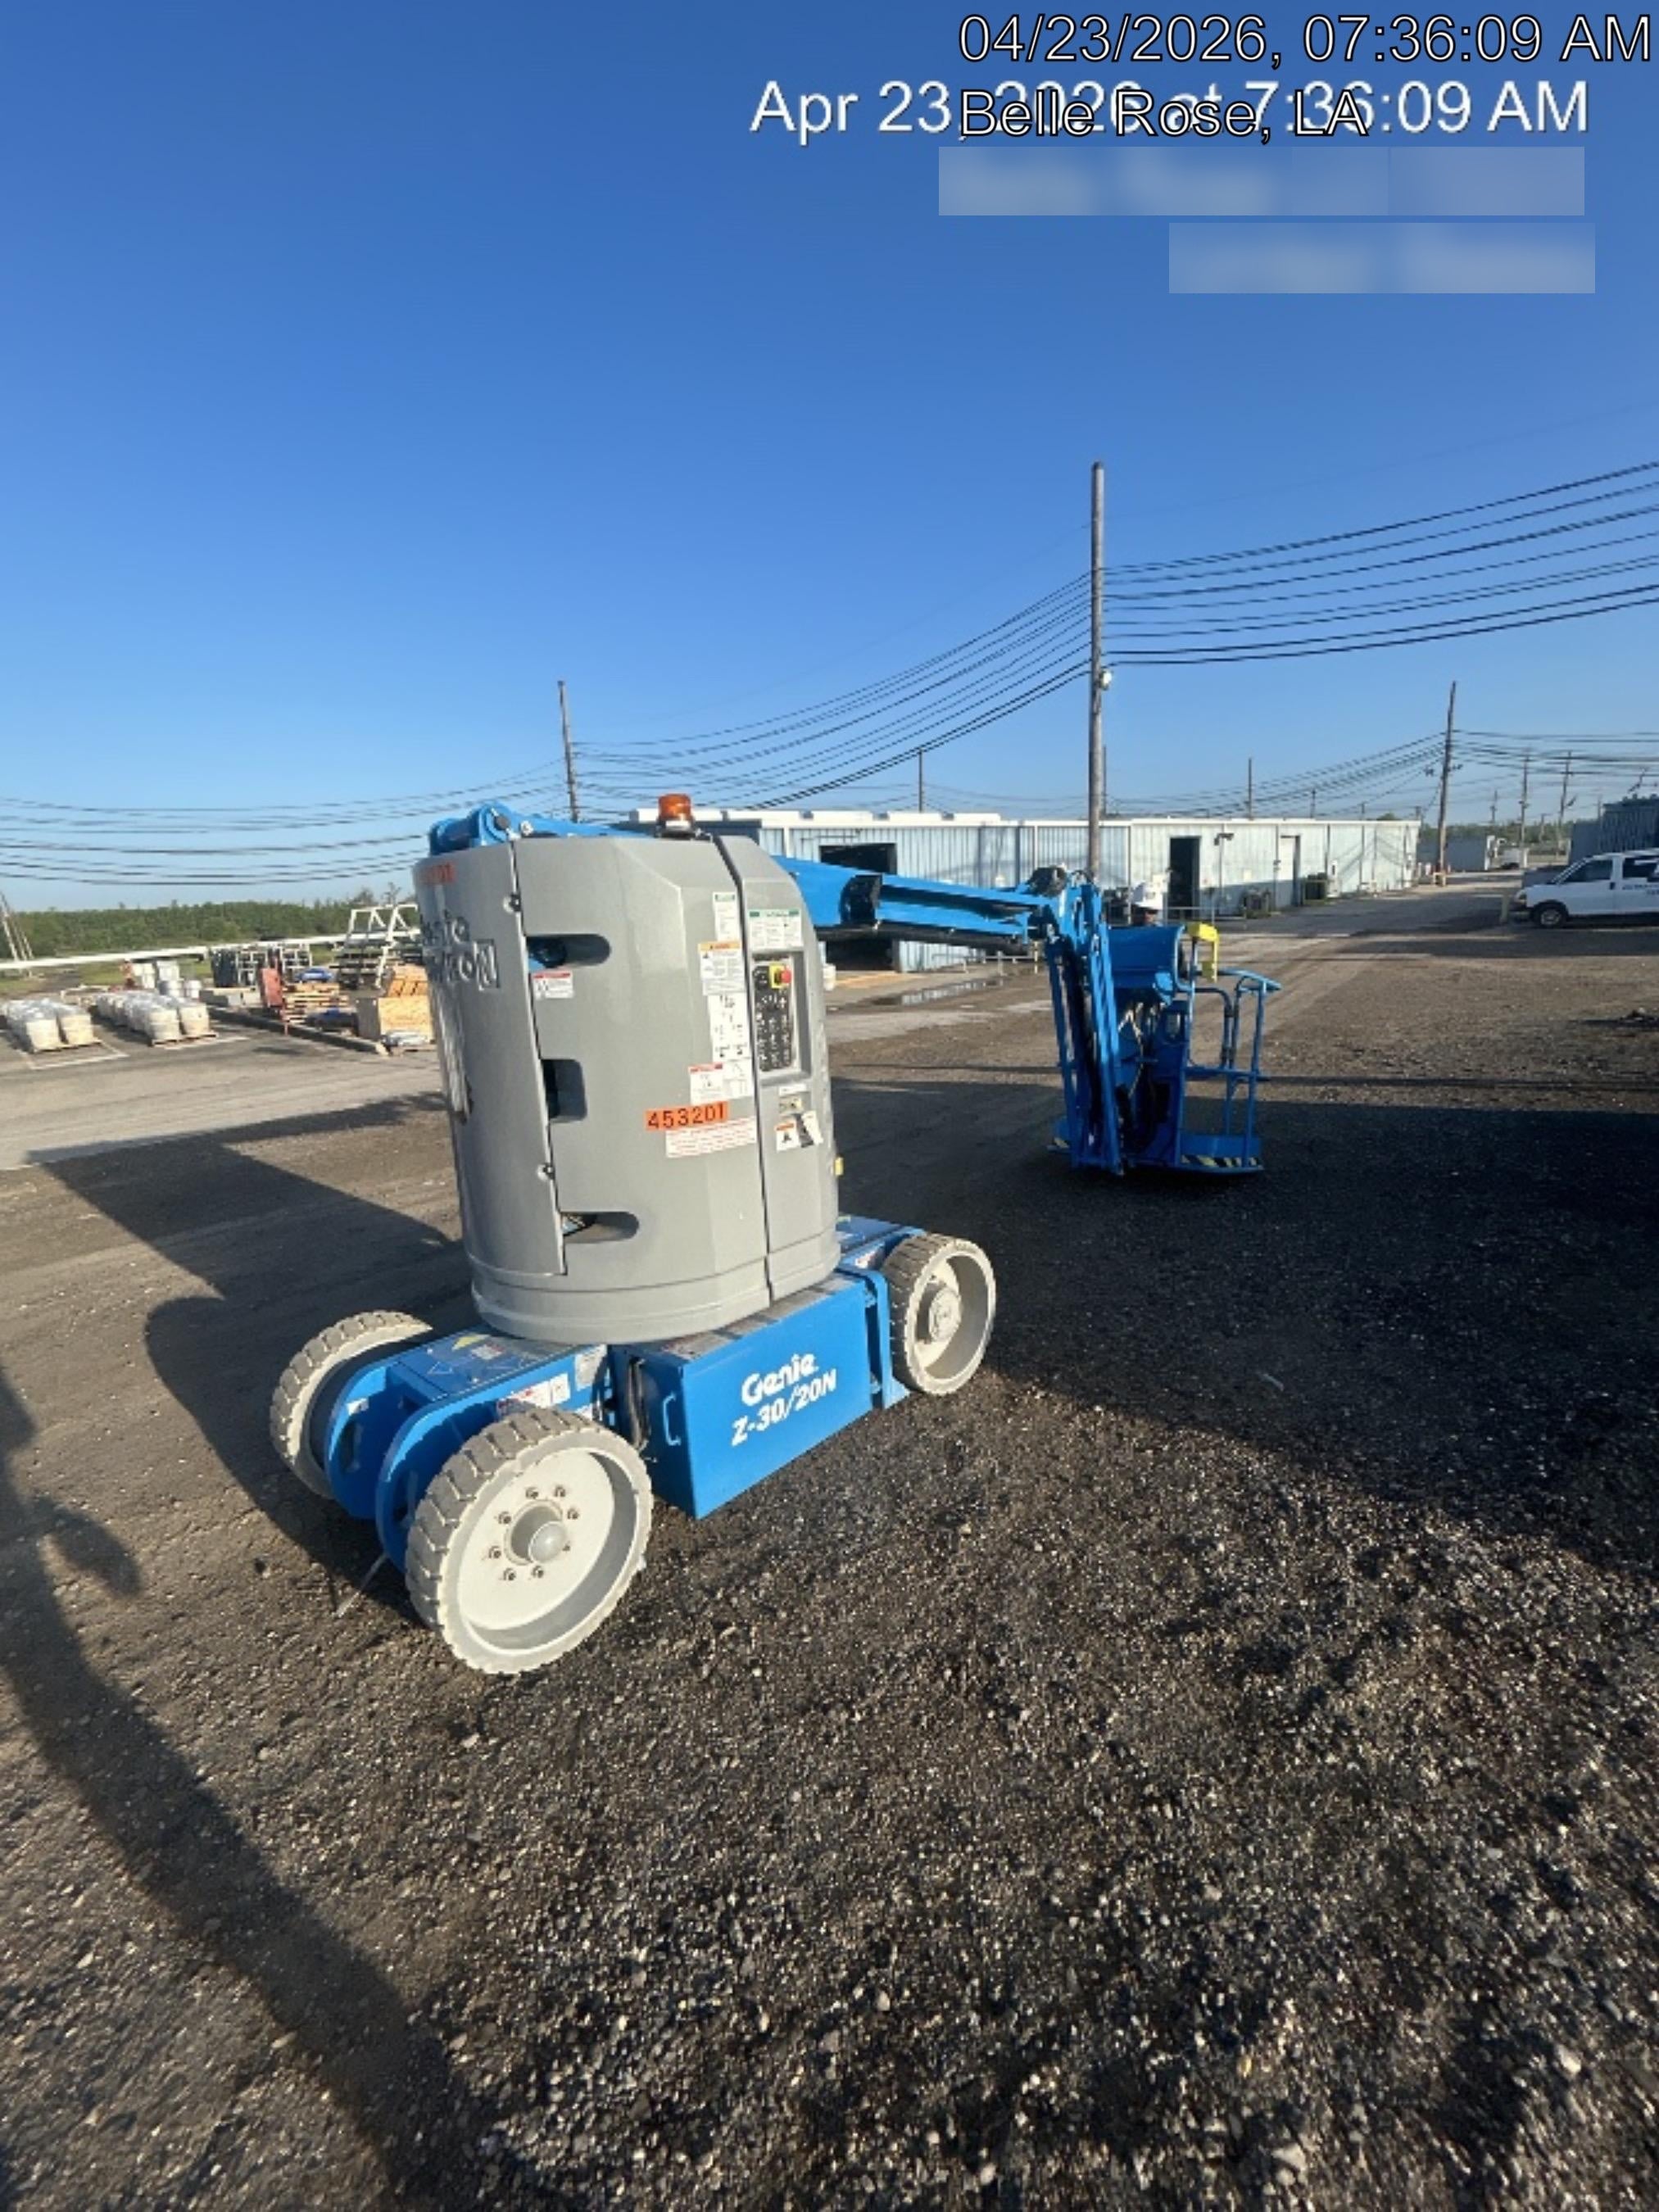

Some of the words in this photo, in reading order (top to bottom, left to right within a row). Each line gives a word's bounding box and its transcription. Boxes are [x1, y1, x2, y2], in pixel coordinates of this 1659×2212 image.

[647, 1103, 724, 1130] 453201
[731, 1367, 838, 1447] Z-30/20N
[741, 1352, 819, 1407] Genie
